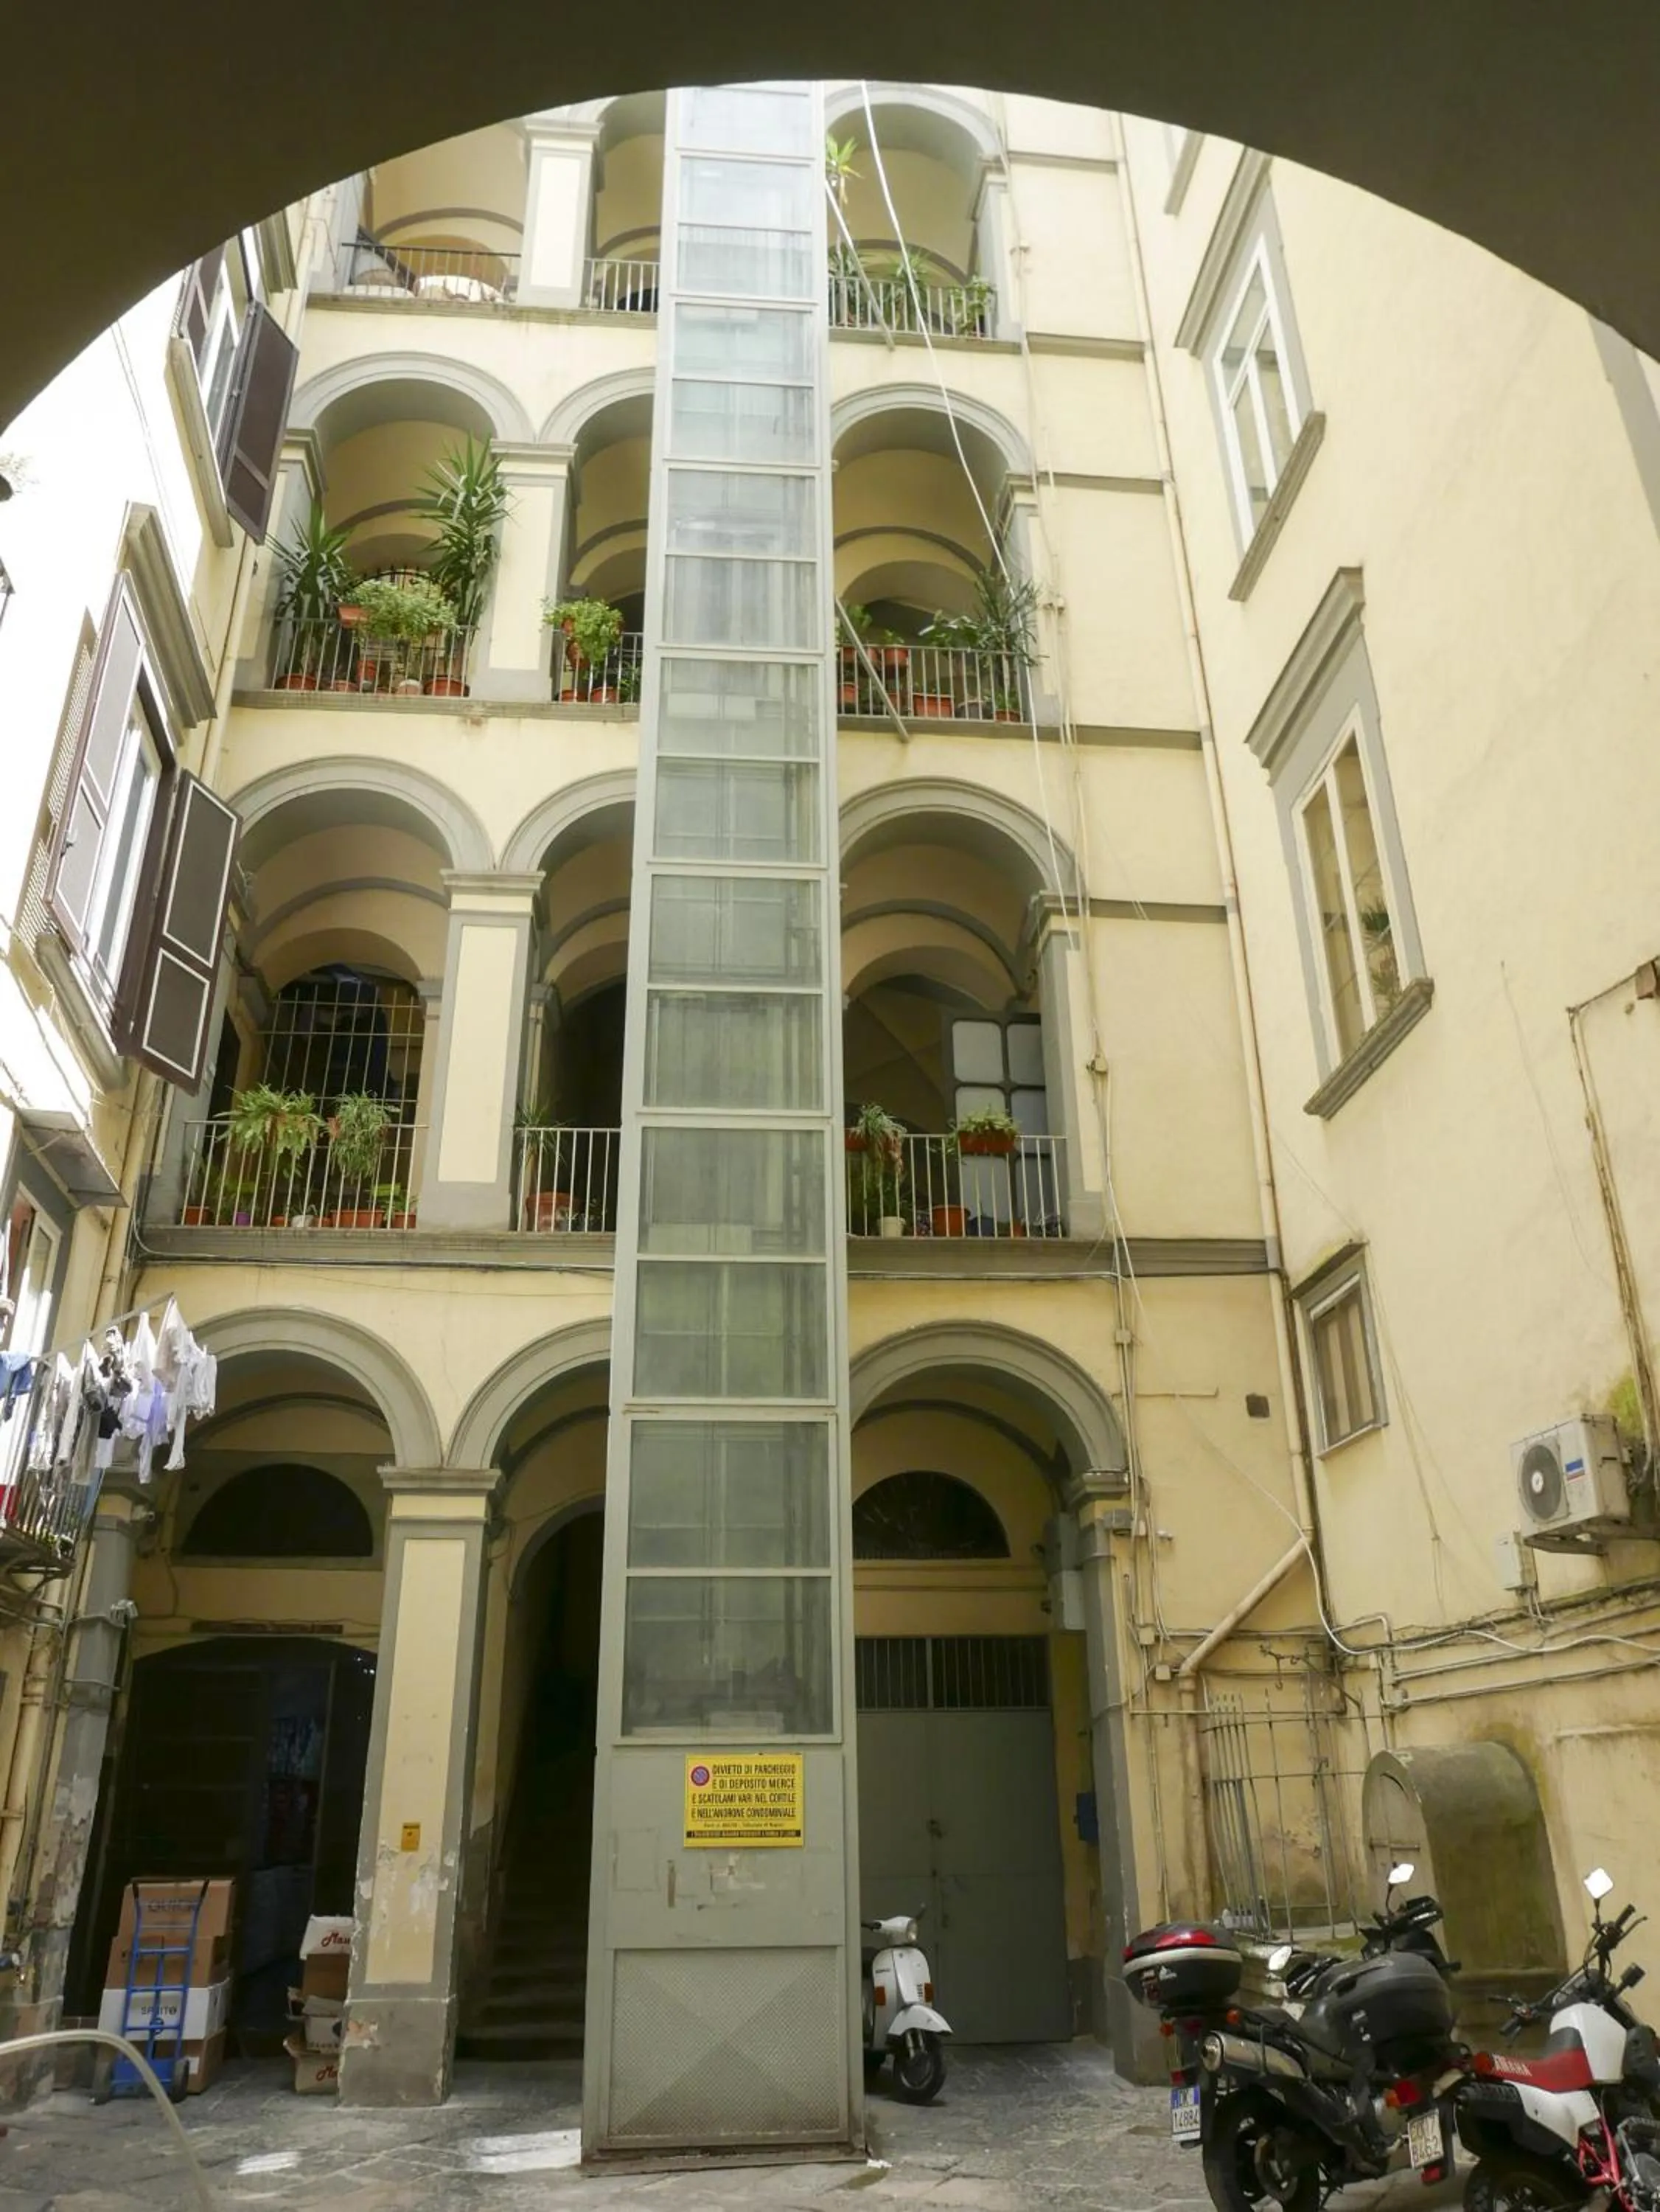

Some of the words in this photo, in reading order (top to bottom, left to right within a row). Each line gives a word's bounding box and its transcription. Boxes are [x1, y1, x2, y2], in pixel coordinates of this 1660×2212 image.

[712, 1764, 742, 1775] DIVIETO
[744, 1764, 753, 1775] DI
[712, 1778, 717, 1790] E
[719, 1778, 728, 1789] DI
[729, 1778, 767, 1789] DEPOSITO
[769, 1778, 795, 1789] MERCE
[691, 1792, 697, 1804] E
[755, 1792, 767, 1804] NEL
[769, 1792, 796, 1804] CORTILE
[691, 1807, 697, 1819] E
